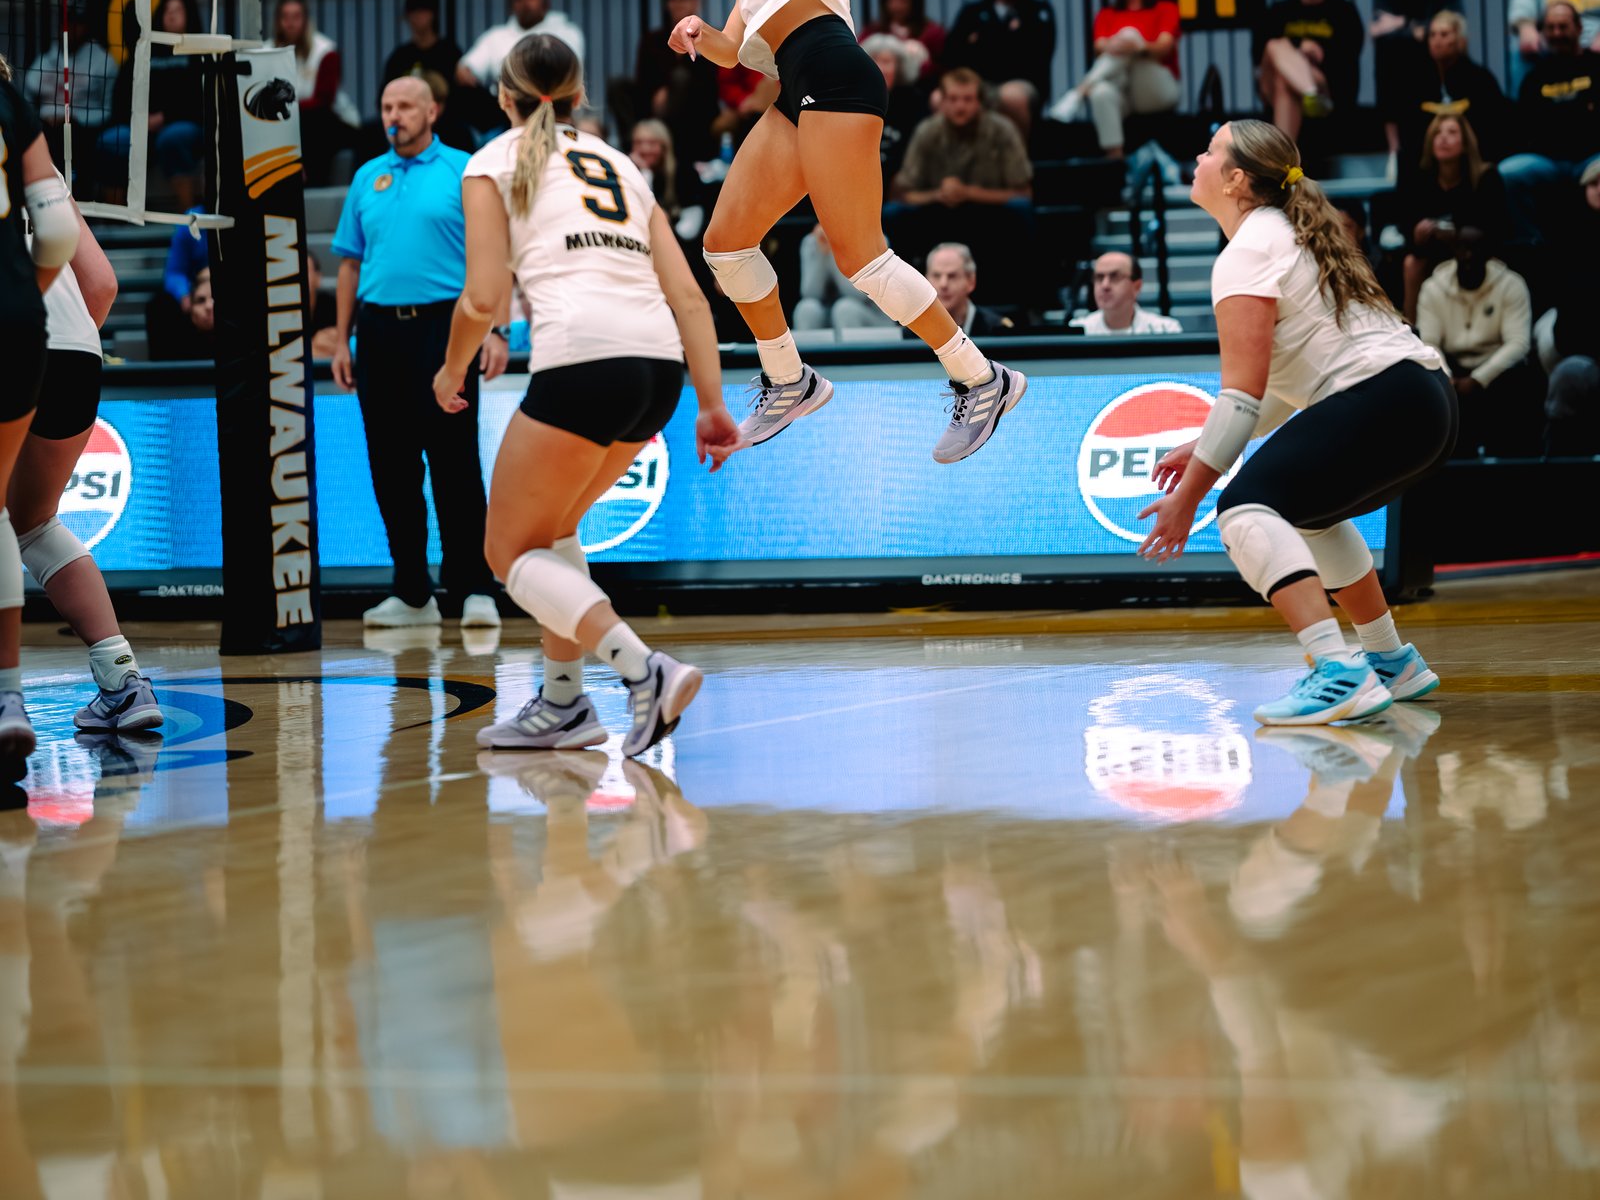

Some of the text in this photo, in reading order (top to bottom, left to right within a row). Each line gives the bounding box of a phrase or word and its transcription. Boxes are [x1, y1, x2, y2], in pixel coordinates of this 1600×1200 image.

[563, 147, 631, 225] 9
[264, 214, 314, 629] MILWAUKEE
[158, 584, 224, 597] DAKTRON
